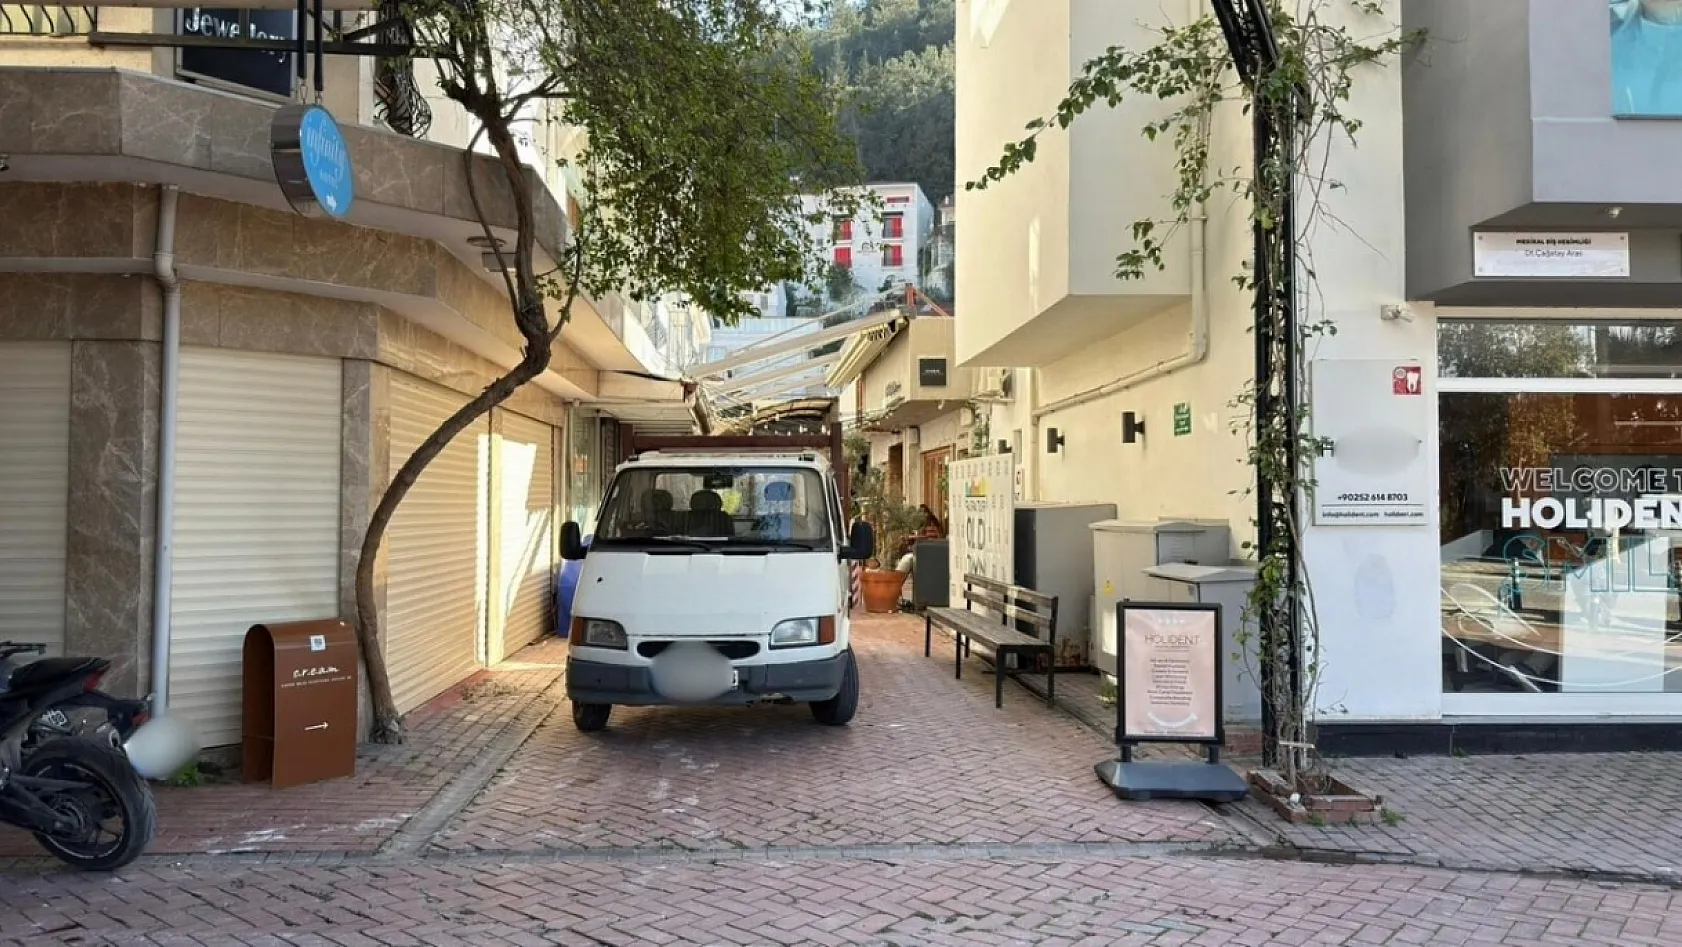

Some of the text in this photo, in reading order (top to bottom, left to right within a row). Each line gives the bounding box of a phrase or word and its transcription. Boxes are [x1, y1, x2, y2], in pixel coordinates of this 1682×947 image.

[1500, 468, 1668, 492] WELCOME
[1502, 497, 1682, 529] HOLIDEN
[1144, 634, 1200, 645] HOLIDENT
